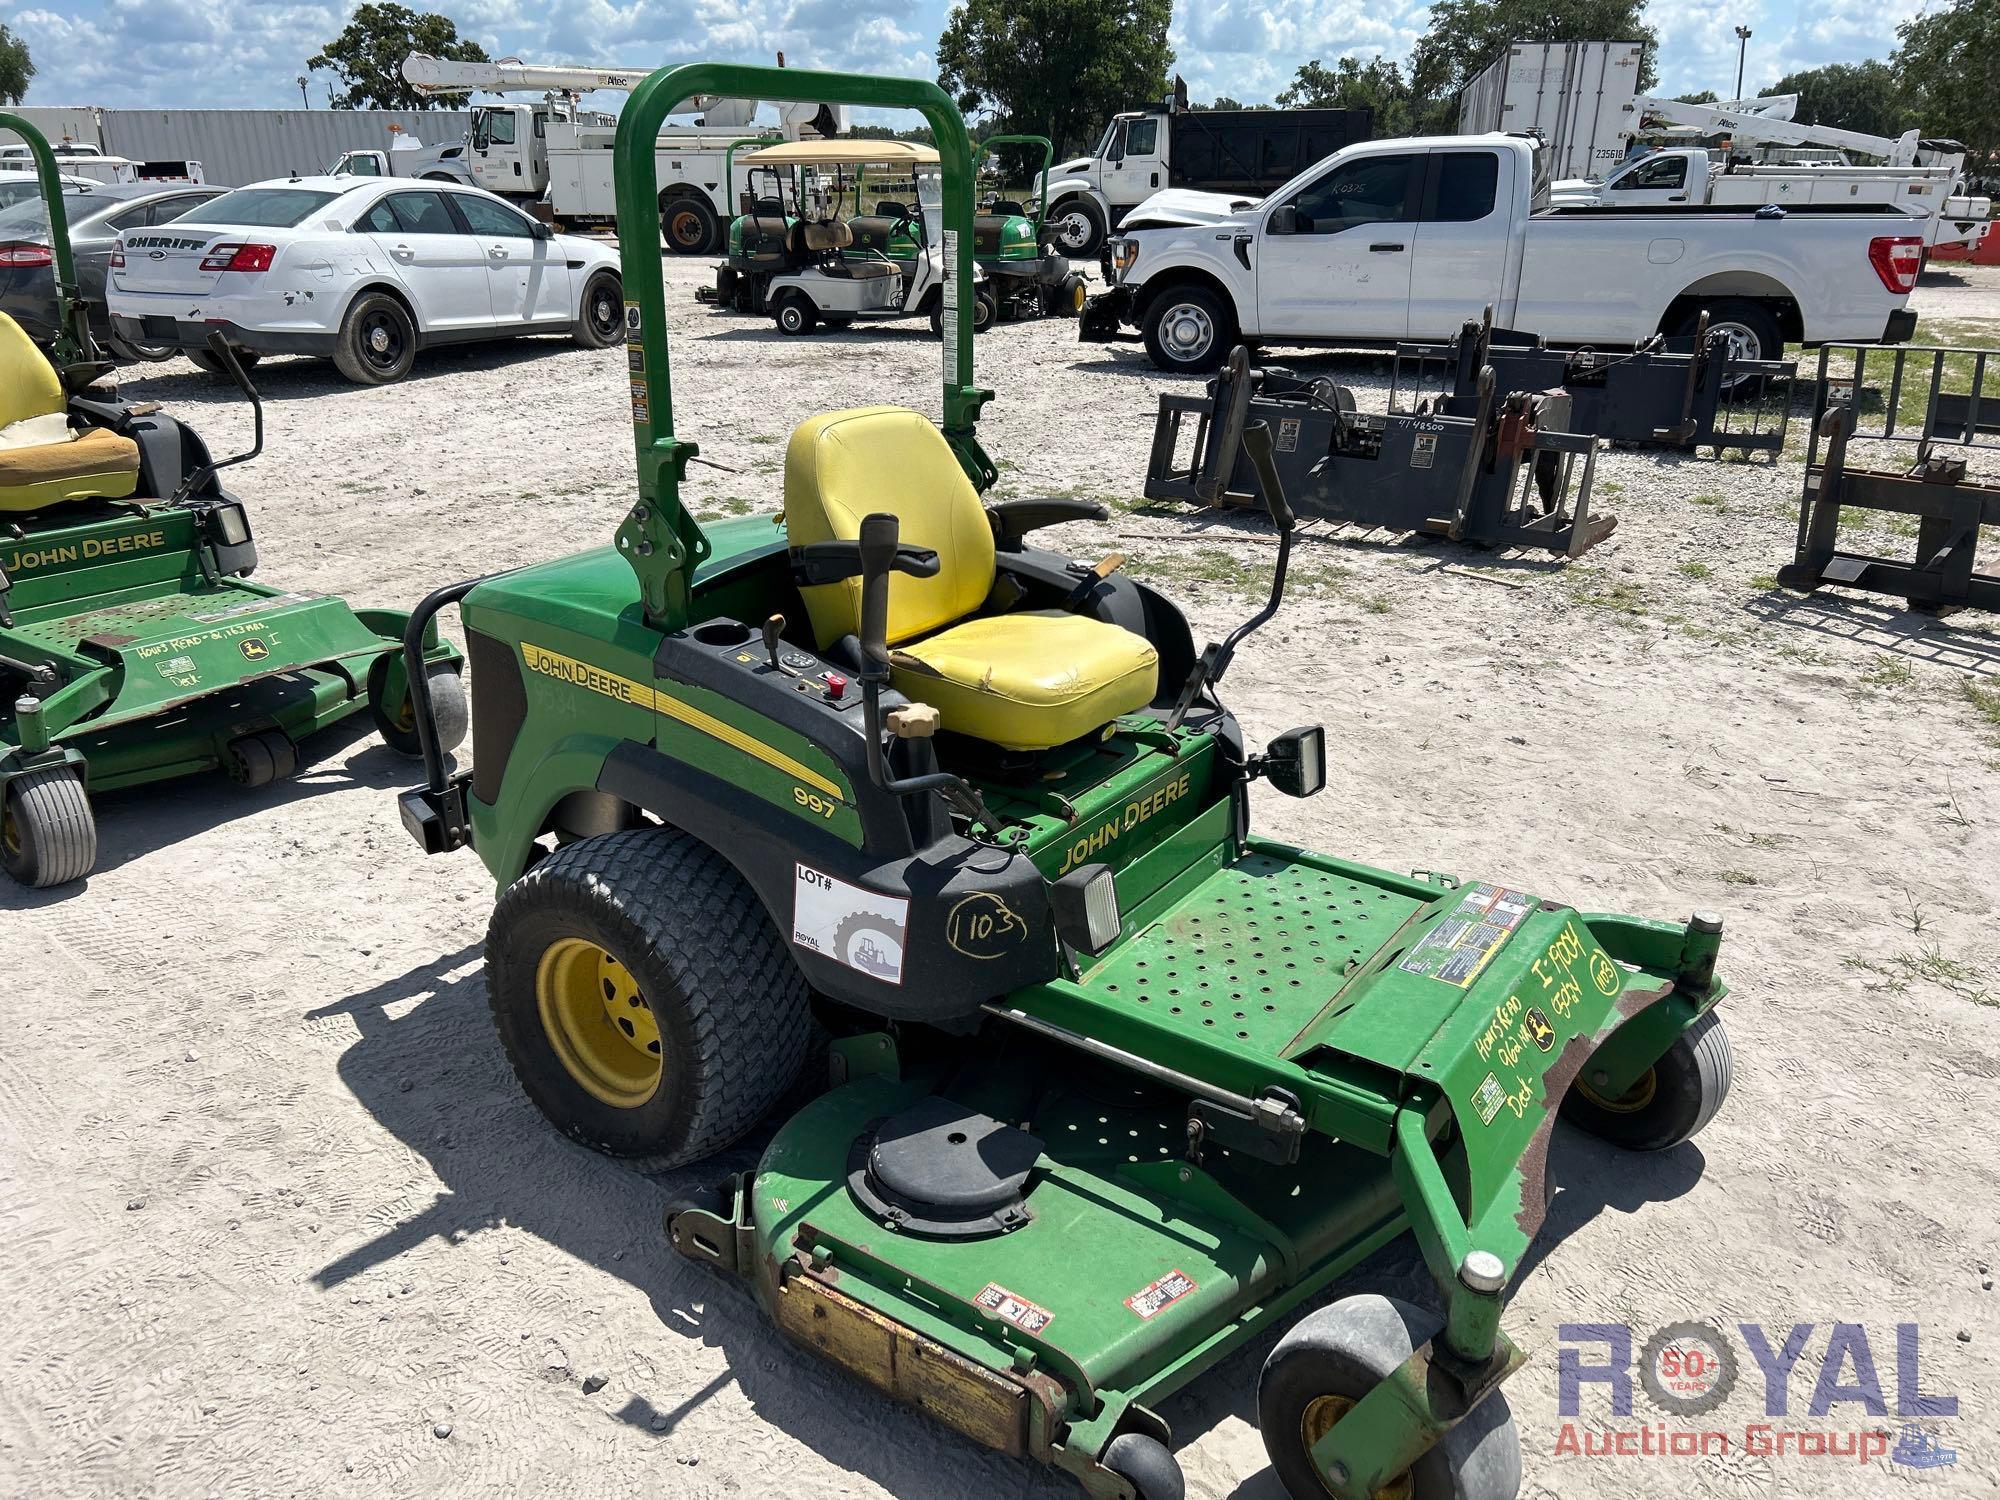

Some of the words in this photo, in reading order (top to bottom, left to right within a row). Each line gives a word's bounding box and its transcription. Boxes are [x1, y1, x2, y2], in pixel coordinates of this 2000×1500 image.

[607, 75, 627, 86] Altec
[1718, 118, 1738, 130] Altec
[1595, 149, 1623, 159] 235618
[127, 237, 208, 250] SHERIFF
[7, 545, 78, 572] JOHN
[82, 530, 165, 559] DEERE
[532, 650, 573, 681] JOHN
[575, 663, 632, 702] DEERE
[793, 786, 836, 819] 997
[1059, 816, 1120, 875] JOHN
[1124, 772, 1191, 833] DEERE
[798, 865, 833, 892] LOT#
[795, 930, 820, 948] ROYAL
